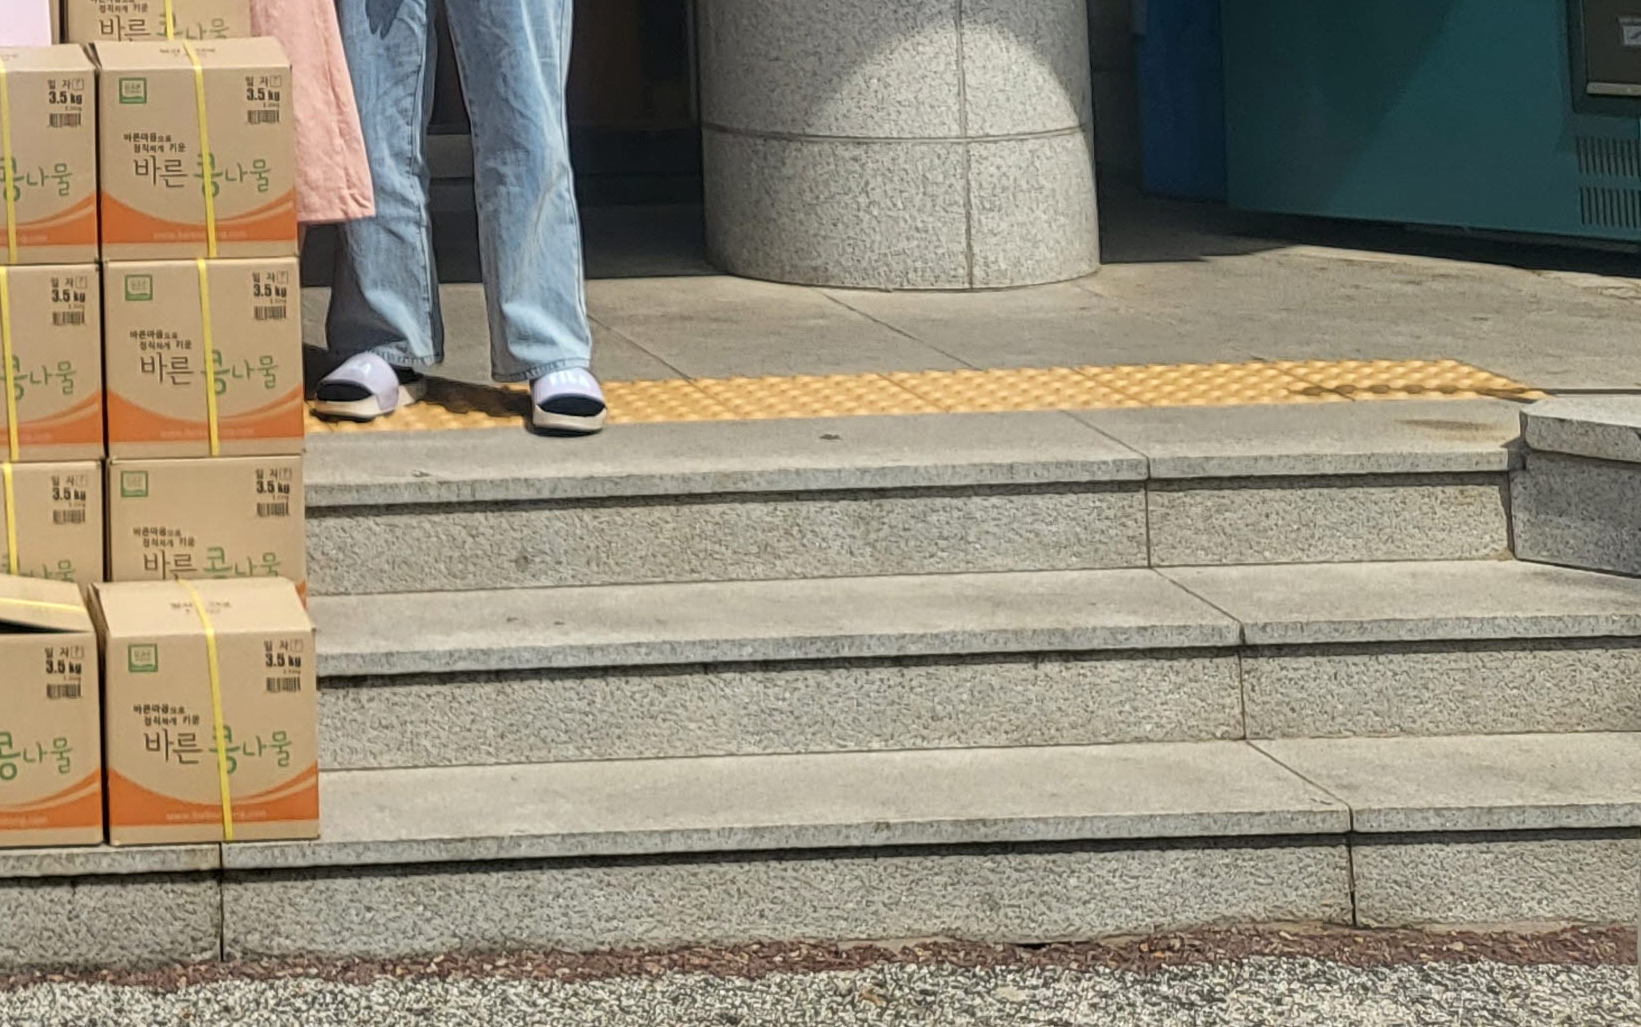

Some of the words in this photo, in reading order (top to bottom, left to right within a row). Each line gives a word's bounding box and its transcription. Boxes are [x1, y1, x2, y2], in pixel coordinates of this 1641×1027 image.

[49, 92, 68, 104] 3.5
[70, 93, 82, 106] kg
[247, 88, 265, 101] 3.5
[268, 89, 280, 102] kg
[134, 155, 187, 188] 바른
[51, 290, 70, 302] 3.5
[73, 291, 86, 303] kg
[253, 284, 271, 297] 3.5
[274, 286, 287, 298] kg
[140, 352, 193, 385] 바른
[257, 481, 274, 493] 3.5
[277, 482, 290, 494] kg
[53, 488, 71, 501] 3.5
[73, 489, 86, 502] kg
[46, 660, 65, 673] 3.5
[68, 661, 81, 674] kg
[265, 653, 285, 667] 3.5
[288, 655, 301, 668] kg
[144, 729, 202, 764] 바른
